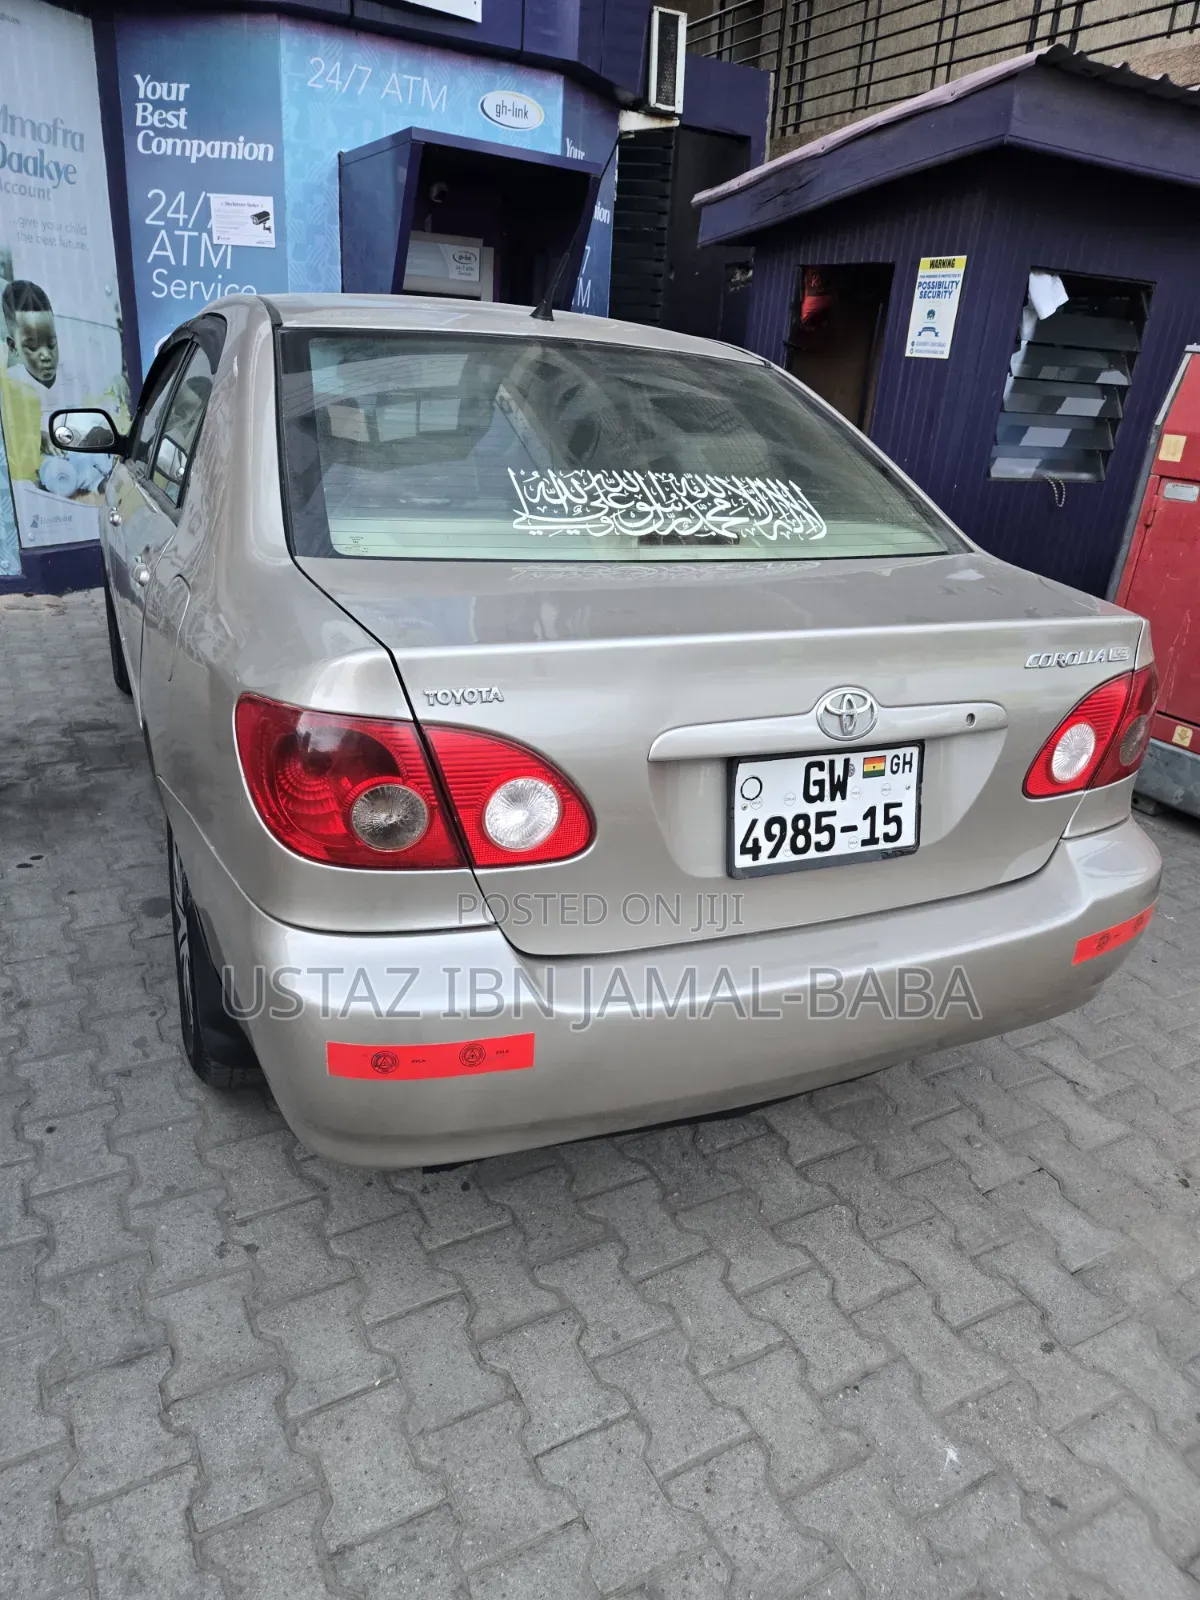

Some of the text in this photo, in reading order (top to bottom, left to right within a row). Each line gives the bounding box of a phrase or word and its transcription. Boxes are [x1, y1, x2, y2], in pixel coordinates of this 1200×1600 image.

[134, 74, 190, 101] Your
[307, 57, 448, 113] 24/7 ATM
[135, 102, 188, 130] Best
[495, 99, 529, 120] gh-link
[137, 129, 274, 164] Companion
[16, 230, 33, 244] the
[36, 234, 57, 247] best
[41, 219, 62, 232] your
[65, 222, 87, 237] child
[147, 229, 232, 270] ATM
[929, 258, 956, 269] WARNING
[917, 280, 960, 290] POSSIBILITY
[919, 290, 953, 299] SECURITY
[40, 515, 73, 525] BestPoint
[1024, 648, 1106, 669] COROLLA
[423, 686, 505, 706] TOYOTA
[803, 752, 914, 804] GW GH
[739, 802, 903, 862] 4985-15
